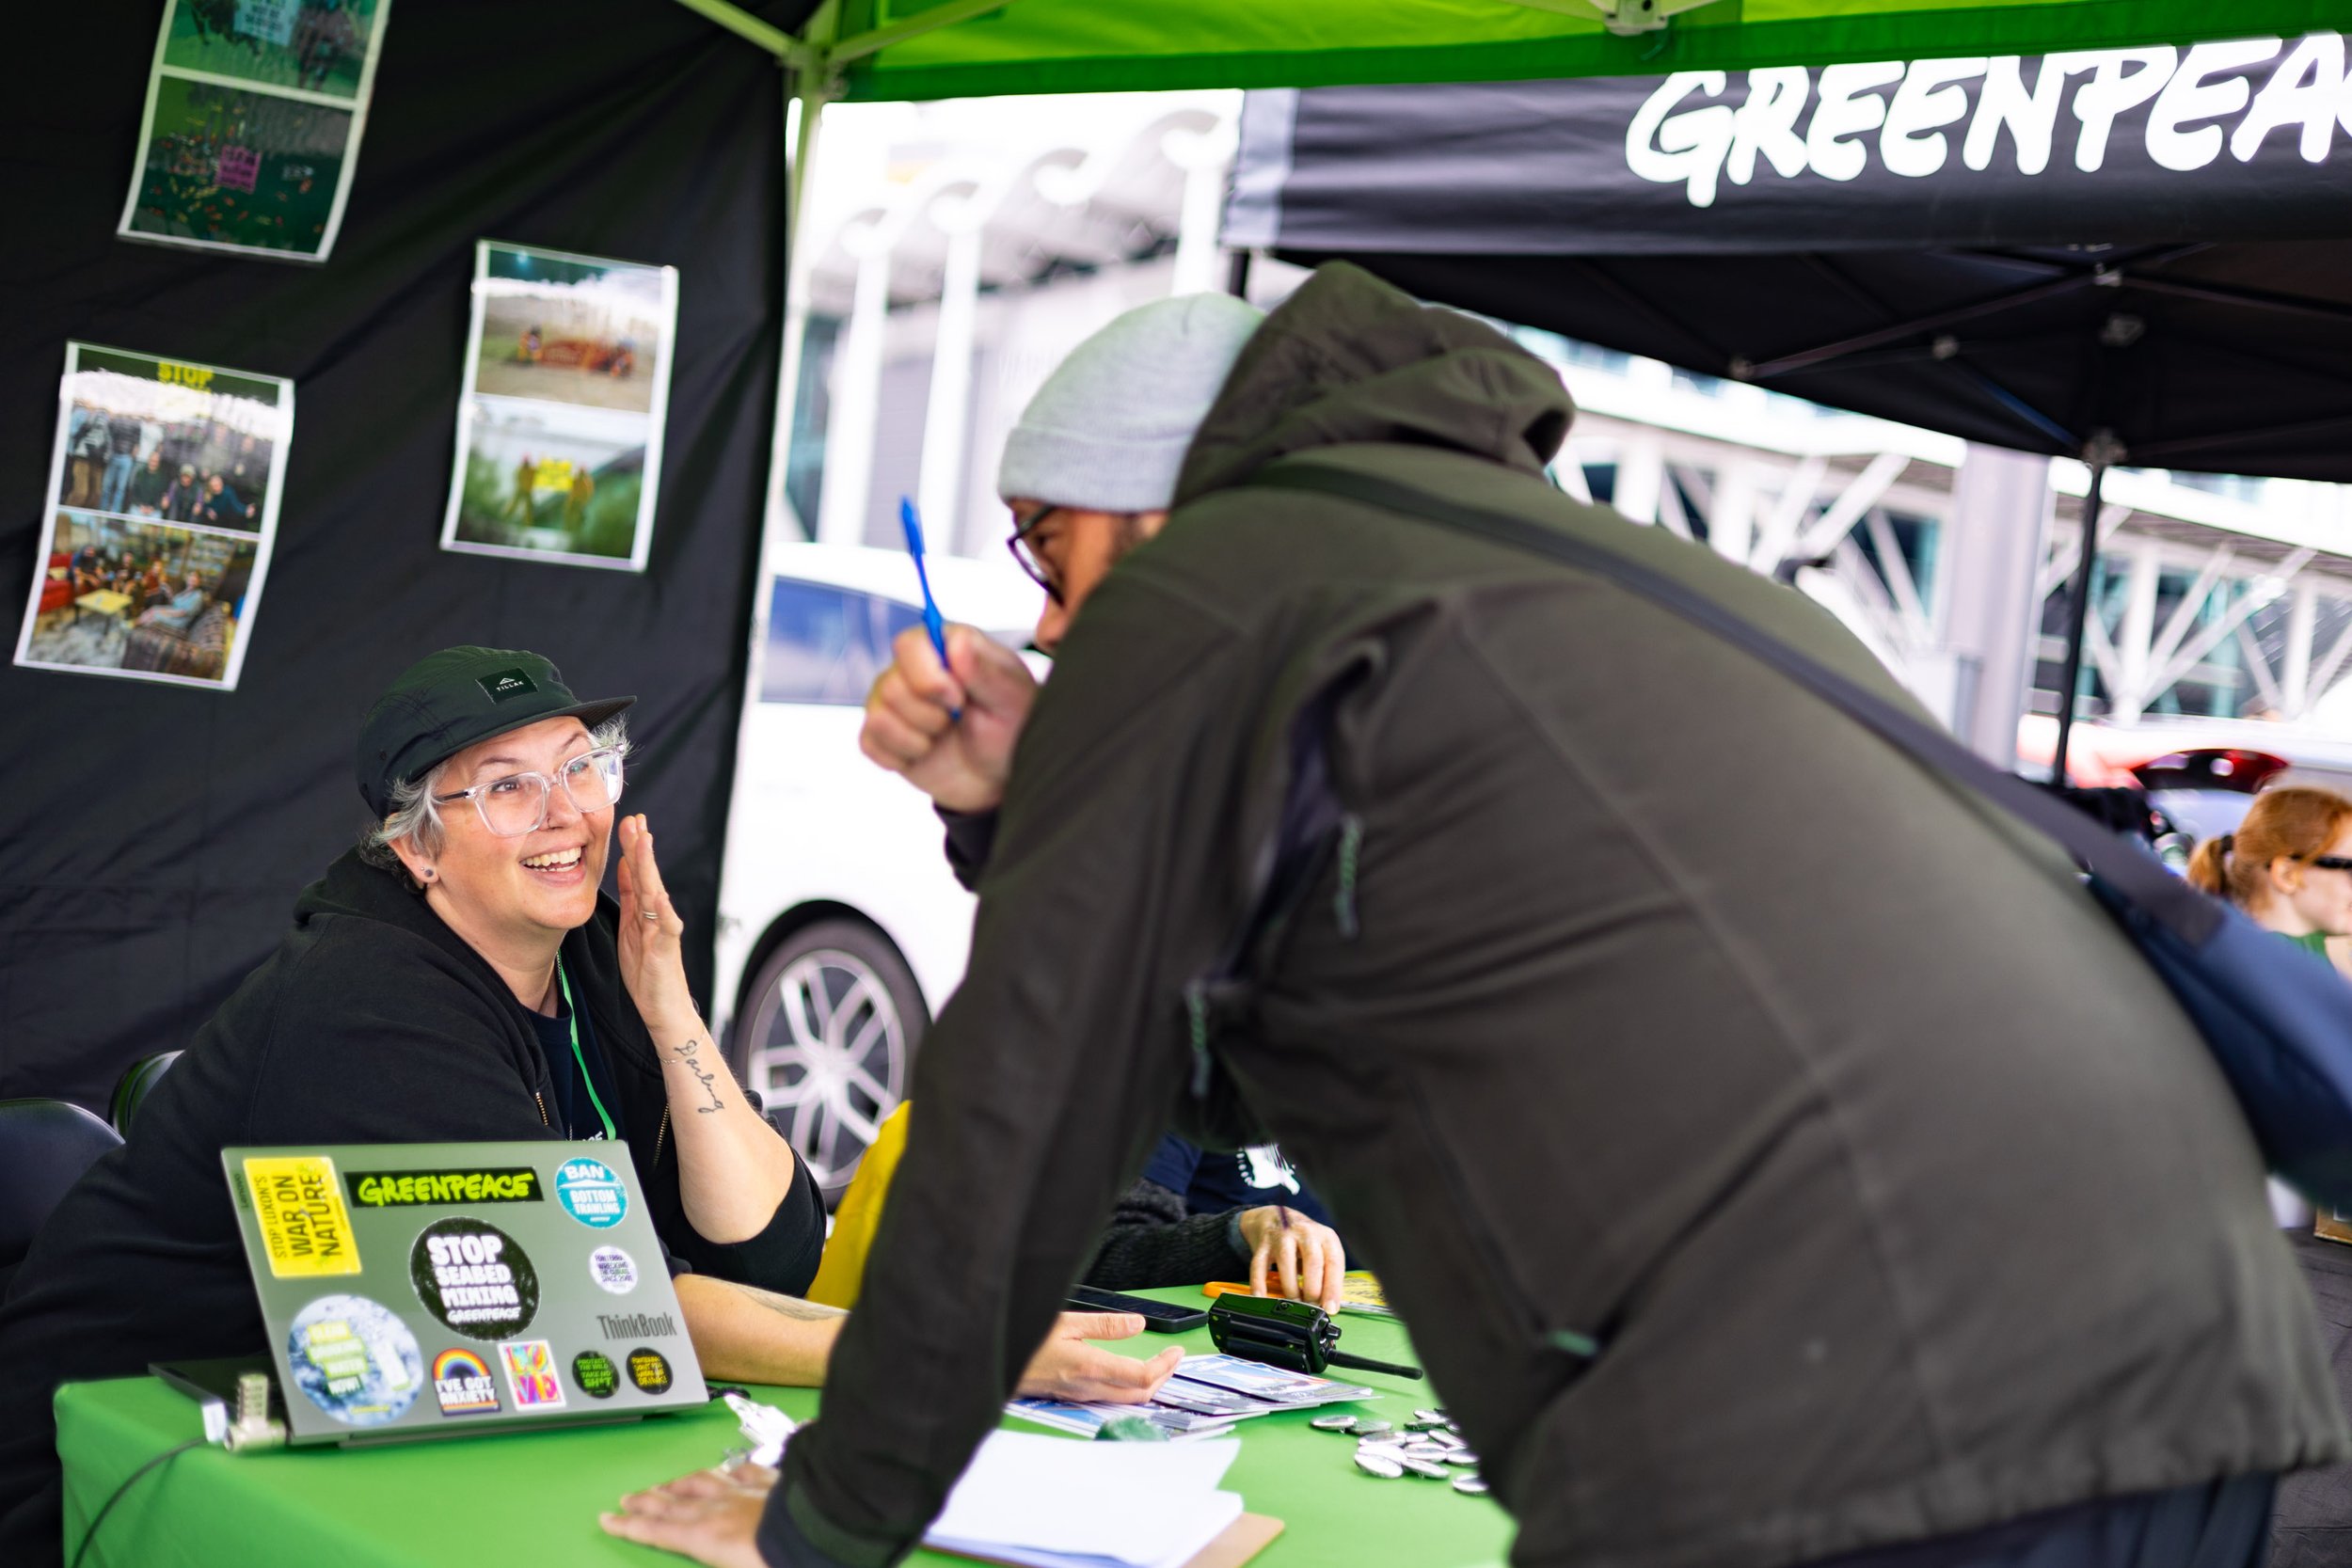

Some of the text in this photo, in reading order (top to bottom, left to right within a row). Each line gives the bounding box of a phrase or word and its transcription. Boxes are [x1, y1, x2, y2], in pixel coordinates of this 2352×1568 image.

[1626, 31, 2352, 208] GREENPEA
[158, 361, 213, 390] STOP
[496, 680, 524, 691] TILLAK
[674, 1039, 725, 1114] Darling
[564, 1164, 604, 1180] BAN
[358, 1173, 533, 1207] GREENPEACE
[569, 1189, 617, 1203] BOTTOM
[254, 1176, 287, 1259] STOP LUXON'S
[273, 1175, 314, 1257] WAR ON
[299, 1174, 342, 1257] NATURE
[574, 1202, 621, 1215] TRAWLING
[427, 1234, 503, 1266] STOP
[435, 1263, 512, 1287] SEABED
[439, 1285, 519, 1308] MINING
[447, 1307, 521, 1324] GREENPEACE
[596, 1311, 677, 1340] ThinkBook
[436, 1375, 491, 1393] I'VE GOT
[438, 1388, 495, 1405] ANXIETY
